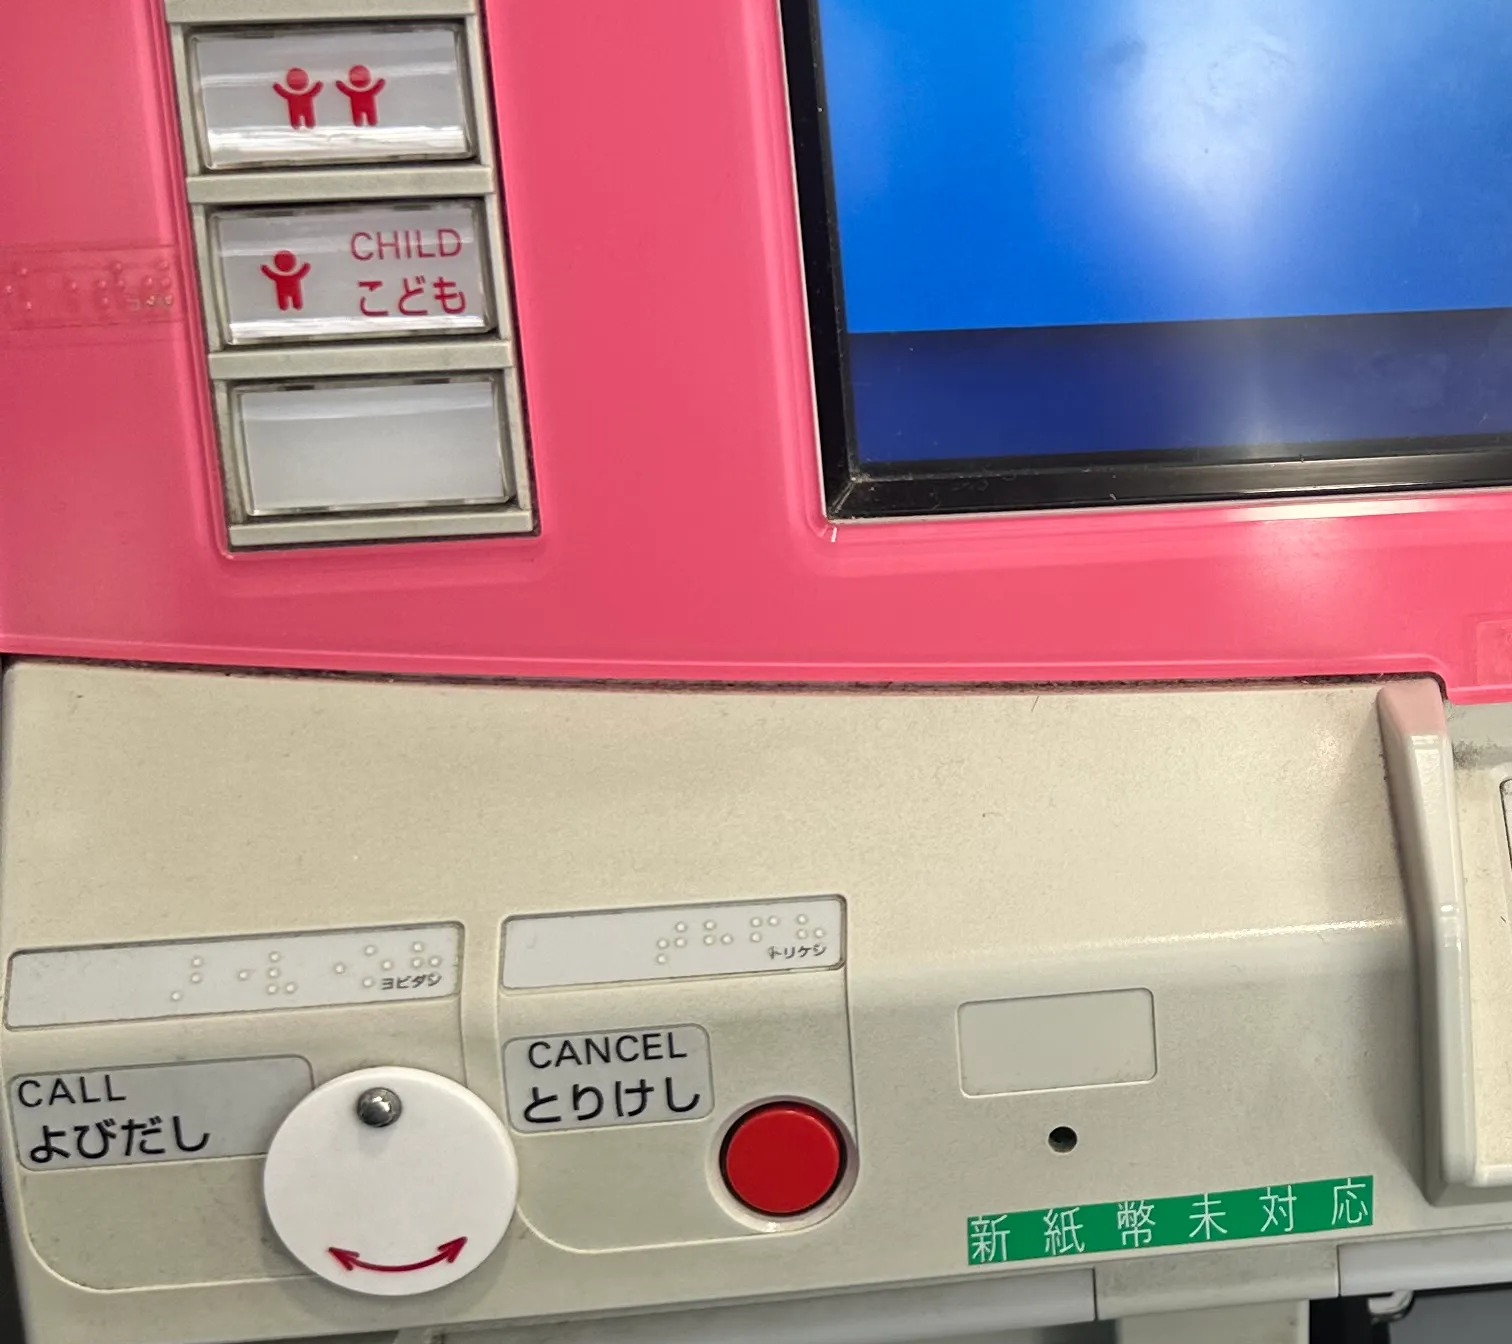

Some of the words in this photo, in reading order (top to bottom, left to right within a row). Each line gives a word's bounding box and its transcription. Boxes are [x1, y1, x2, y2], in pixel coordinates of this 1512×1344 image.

[350, 229, 462, 260] CHILD
[356, 275, 468, 317] こども
[768, 944, 826, 959] トリケシ
[527, 1031, 688, 1070] CANCEL
[17, 1076, 126, 1108] CALL
[521, 1086, 701, 1125] とりけし
[27, 1115, 210, 1164] よびだし
[971, 1178, 1368, 1263] 新紙幣未対応
